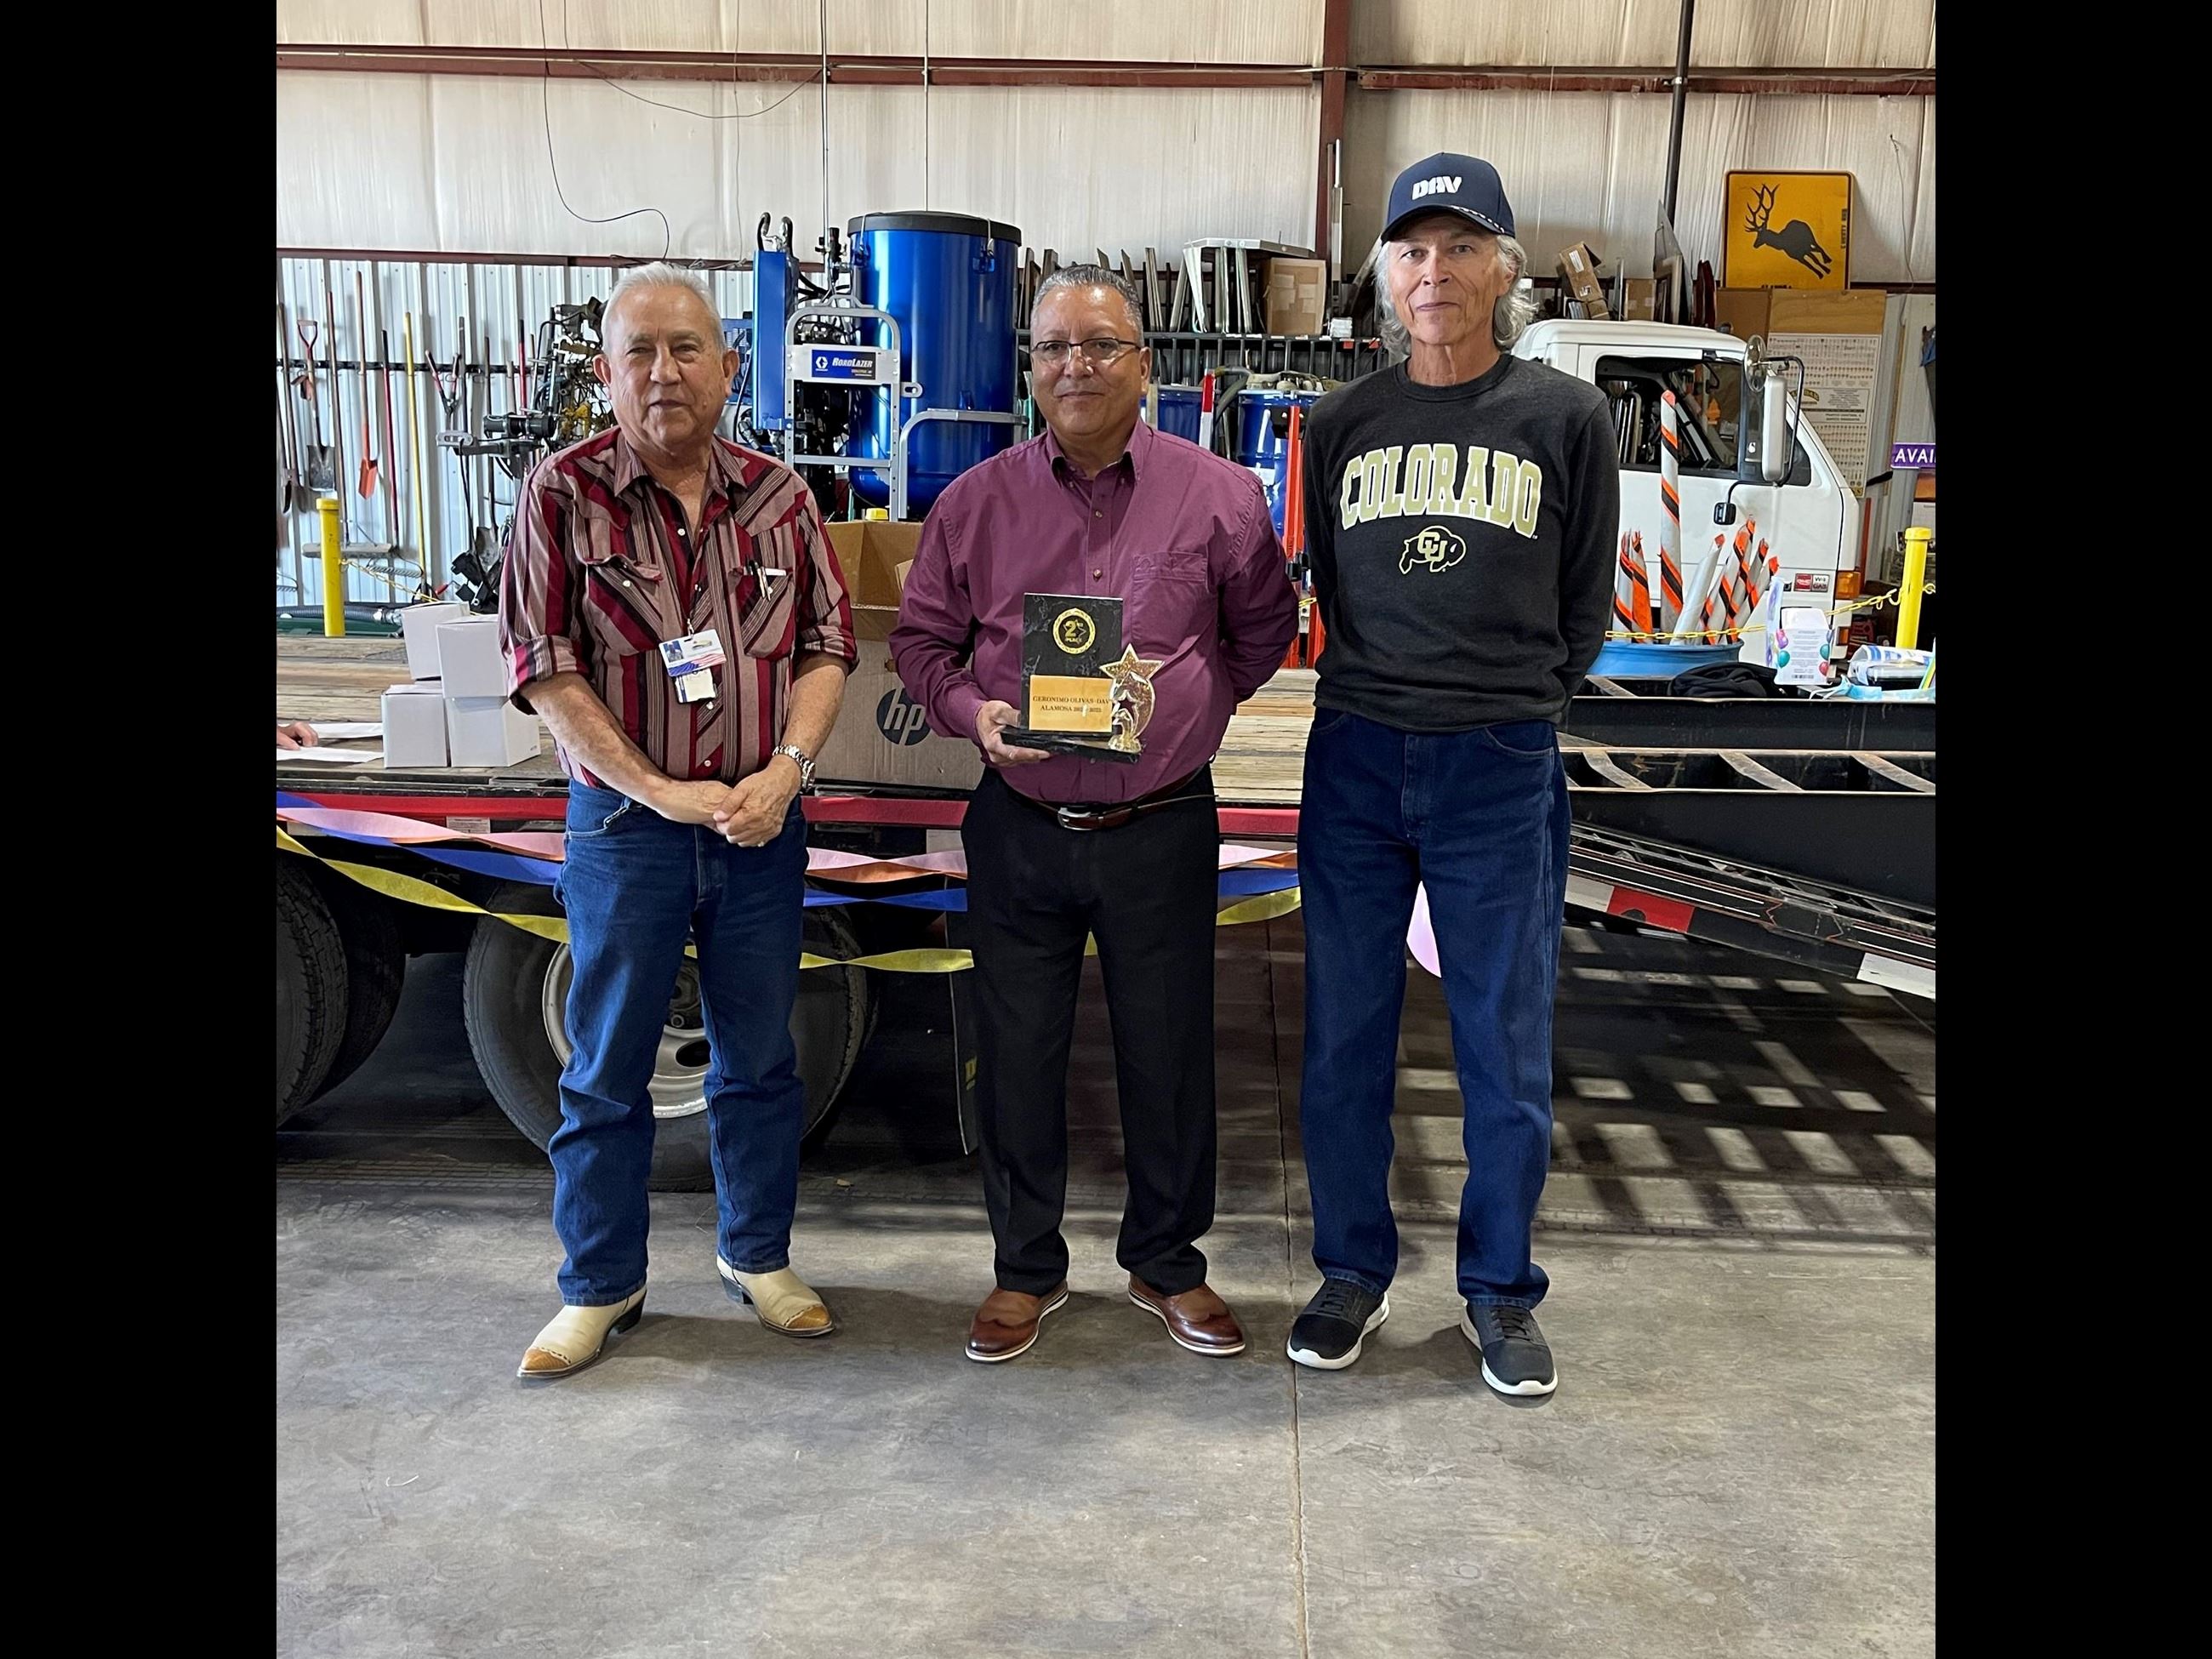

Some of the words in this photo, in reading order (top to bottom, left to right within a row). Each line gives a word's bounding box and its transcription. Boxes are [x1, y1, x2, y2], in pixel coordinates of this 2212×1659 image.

[1412, 176, 1462, 200] DAV
[1895, 448, 1936, 463] AVAI
[1340, 443, 1542, 539] COLORADO
[1417, 532, 1447, 562] CU
[883, 685, 926, 745] hp
